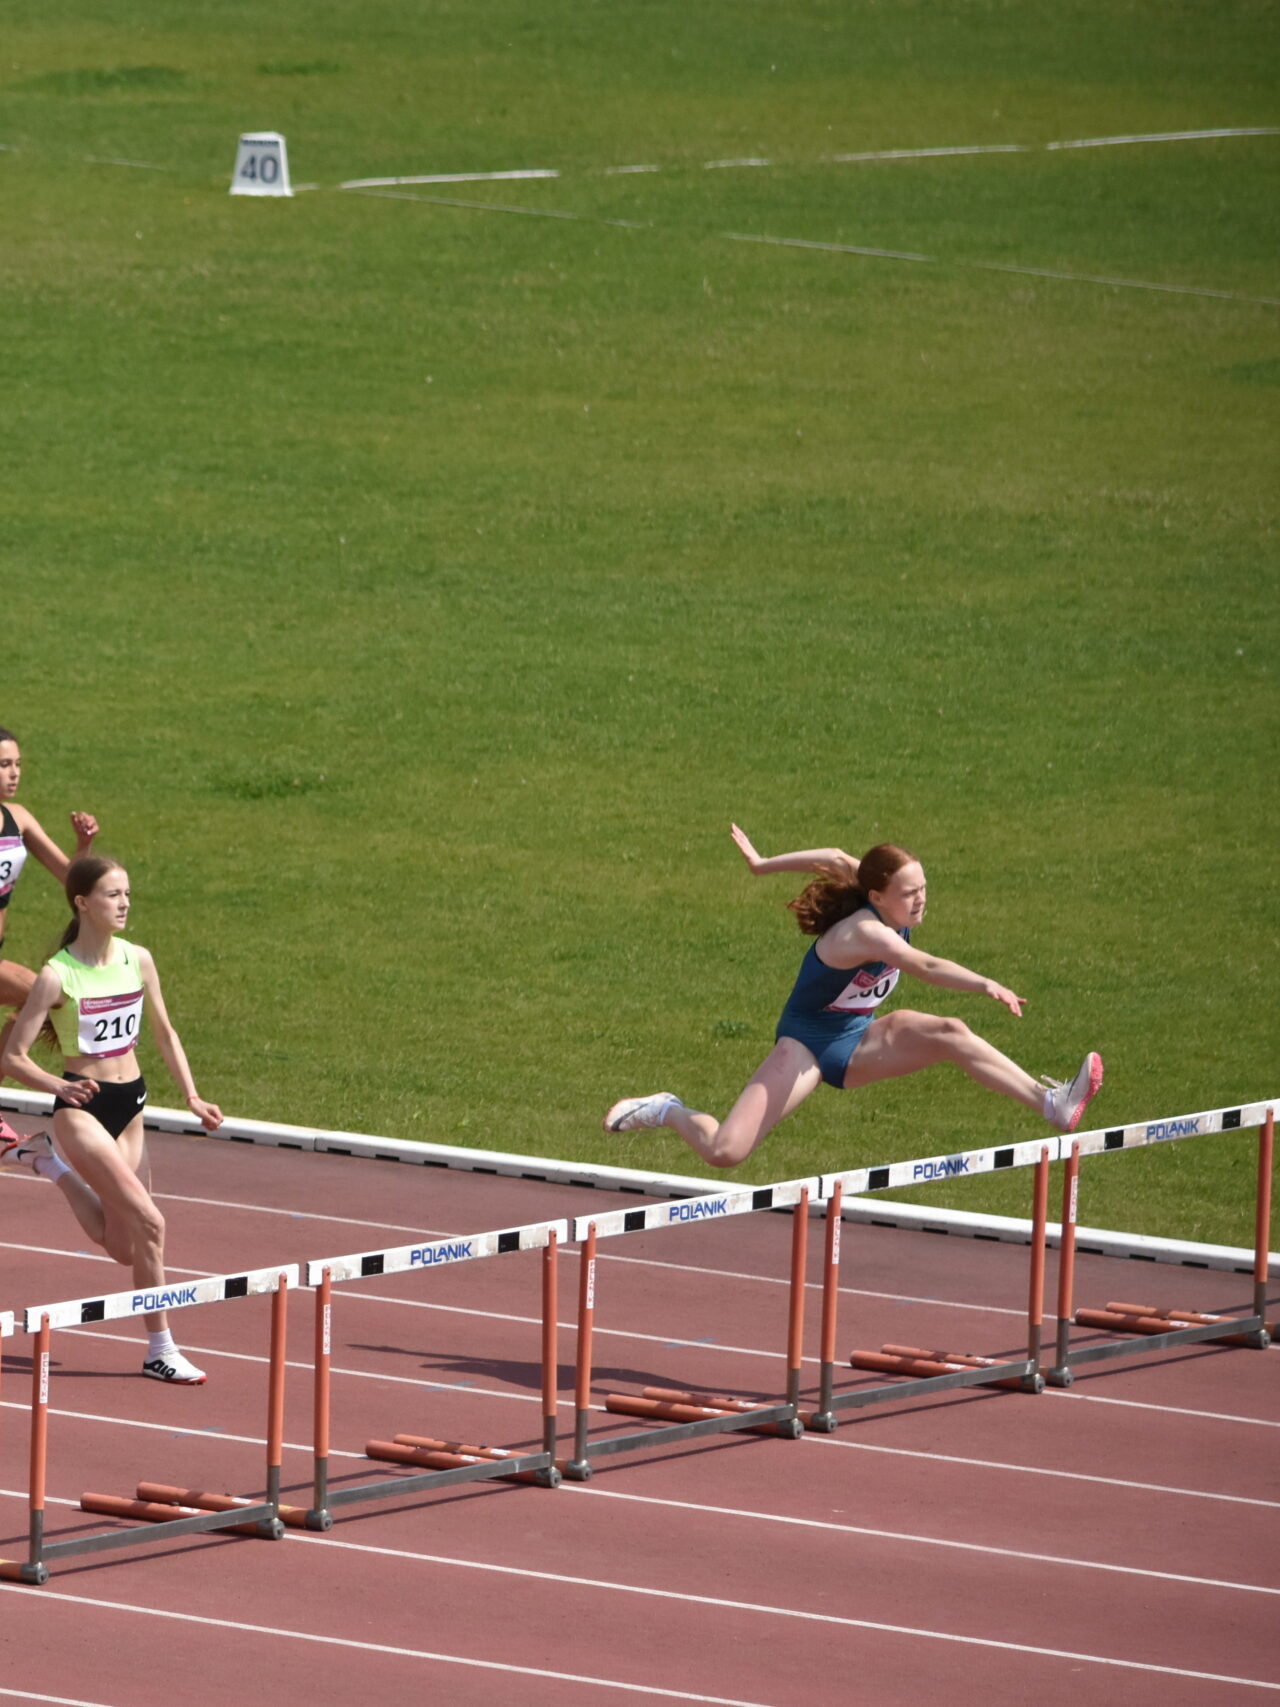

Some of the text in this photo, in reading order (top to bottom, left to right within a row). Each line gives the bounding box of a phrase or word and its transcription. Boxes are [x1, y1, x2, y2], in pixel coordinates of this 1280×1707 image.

[240, 153, 279, 184] 40
[93, 1013, 136, 1042] 210
[1145, 1119, 1200, 1140] POLANIK
[913, 1157, 970, 1180] POLANIK
[669, 1198, 728, 1222] POLANIK
[410, 1241, 472, 1266] POLANIK
[132, 1287, 197, 1312] POLANIK
